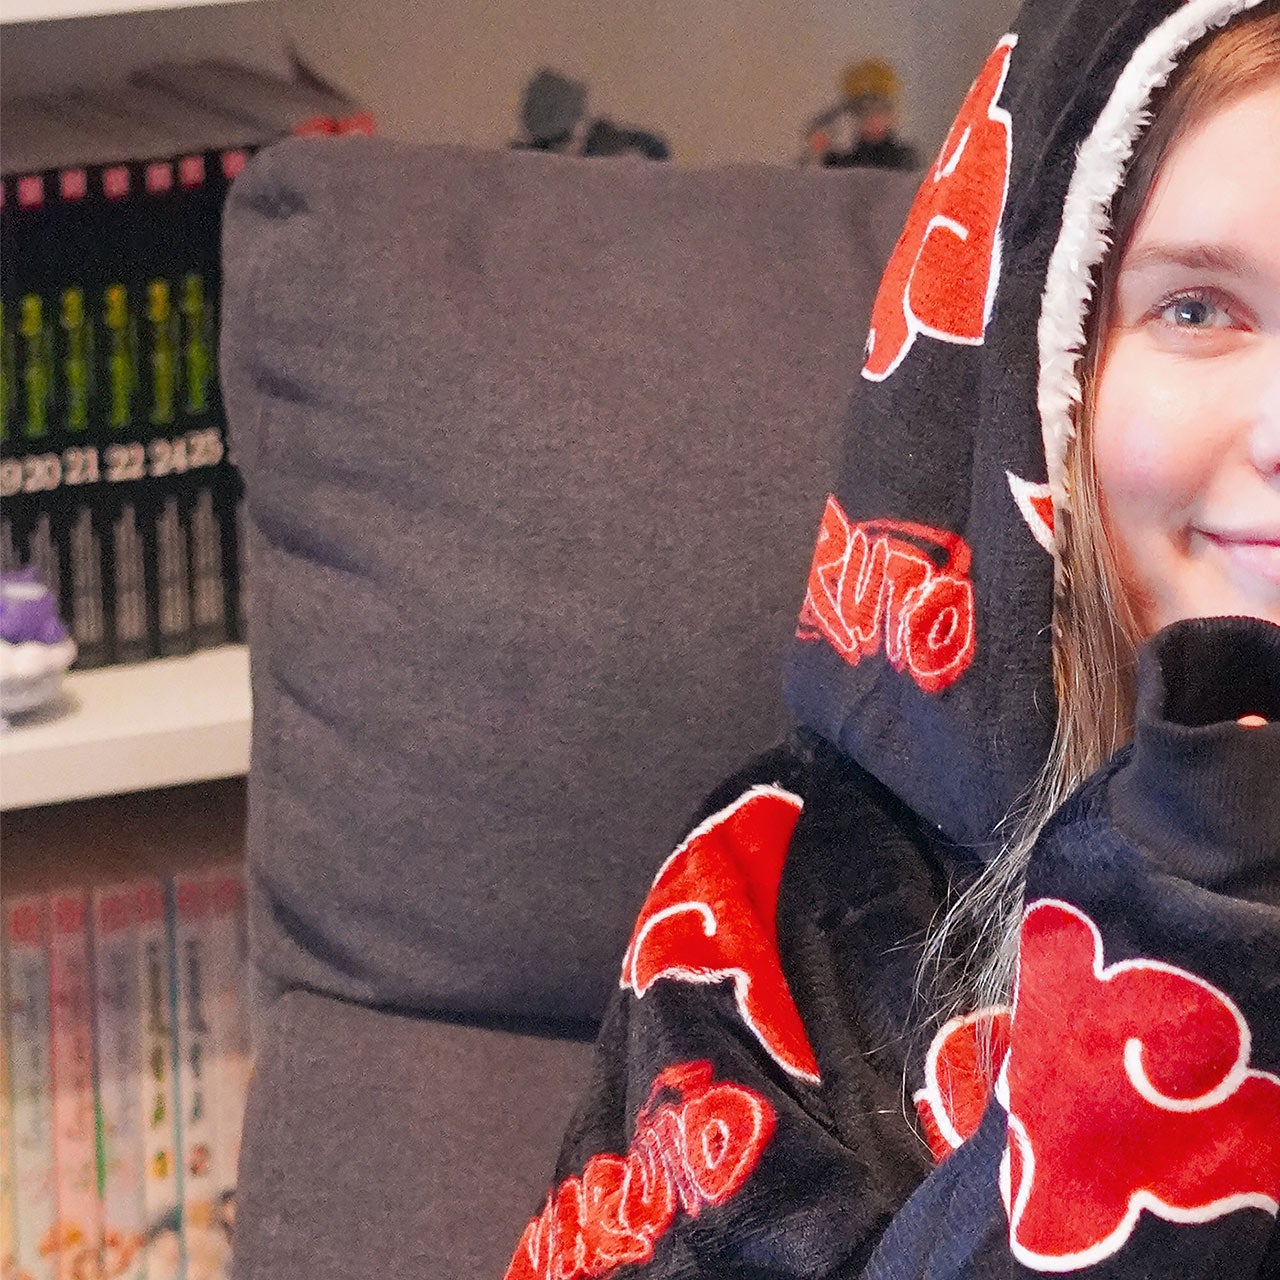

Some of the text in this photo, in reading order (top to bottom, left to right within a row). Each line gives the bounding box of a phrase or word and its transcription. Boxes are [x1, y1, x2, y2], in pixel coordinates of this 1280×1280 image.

[22, 453, 62, 494] 20
[64, 446, 100, 486] 21
[105, 441, 147, 482] 22
